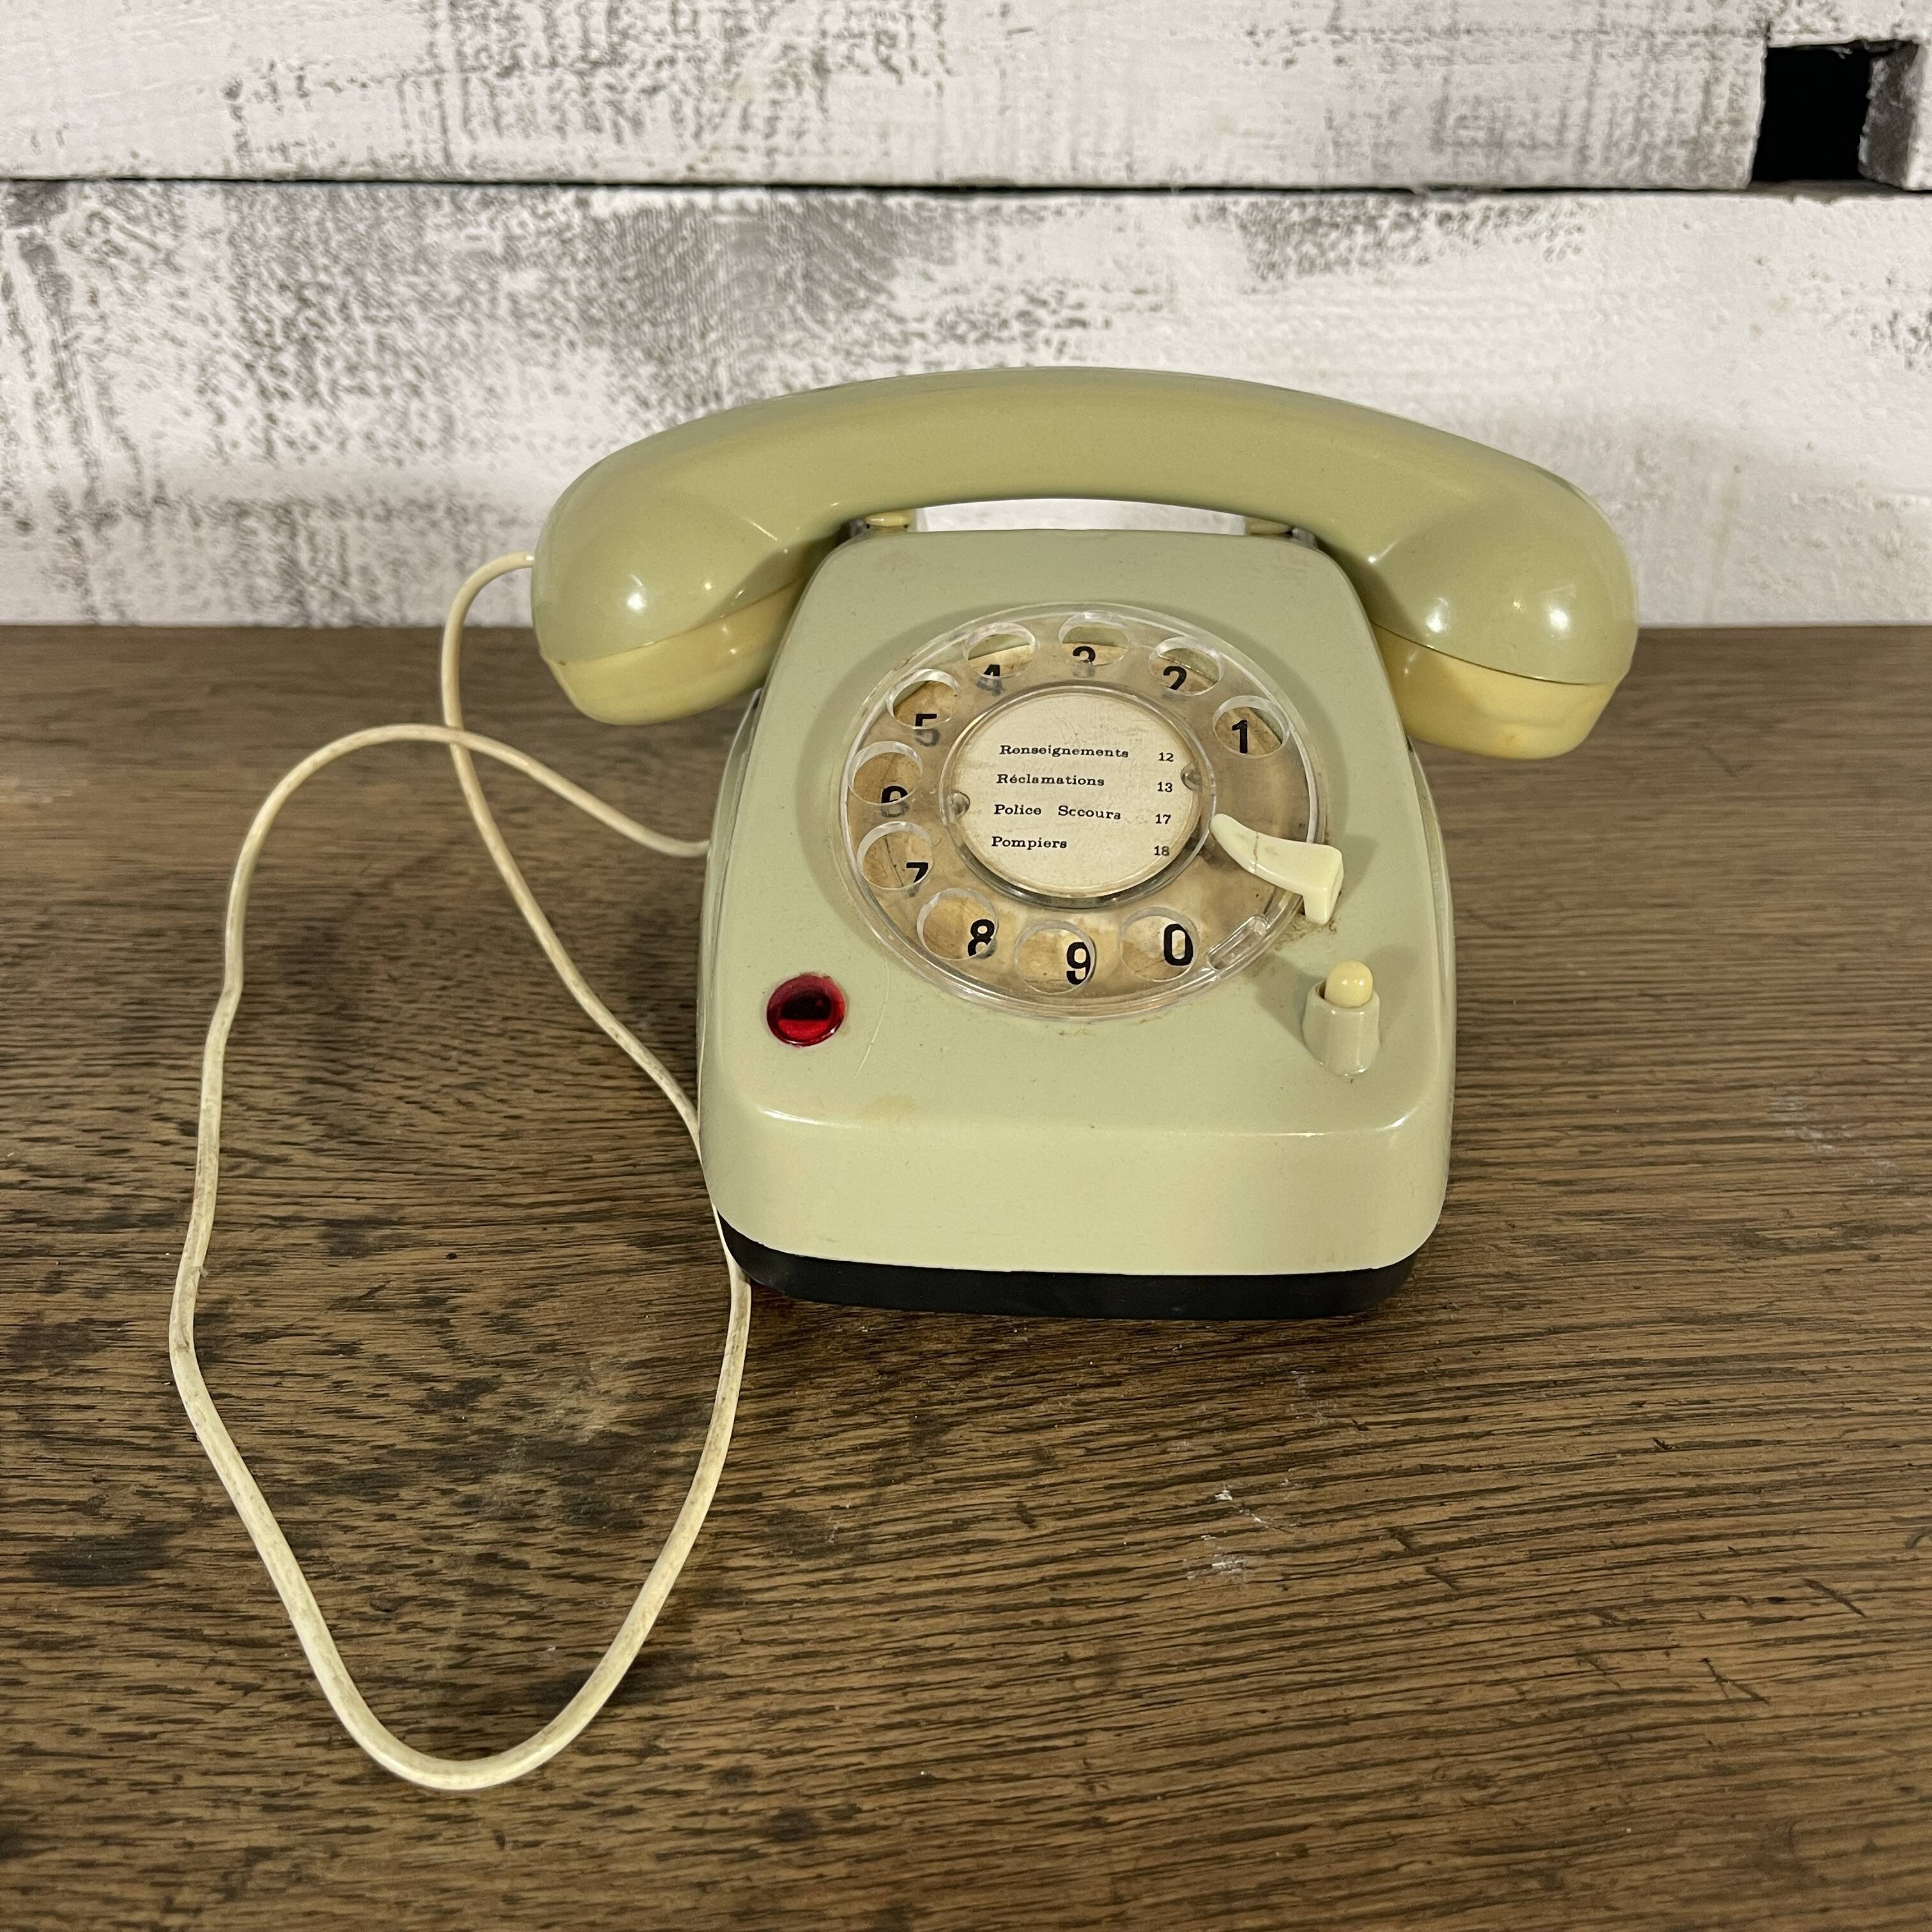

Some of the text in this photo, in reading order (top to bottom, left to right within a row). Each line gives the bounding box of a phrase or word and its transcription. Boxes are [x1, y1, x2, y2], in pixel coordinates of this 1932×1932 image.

[999, 745, 1174, 762] Renseignements 12
[1231, 719, 1248, 755] 1
[996, 774, 1173, 793] Réclamations 13
[993, 804, 1042, 816] Police
[1155, 813, 1172, 825] 17
[991, 836, 1170, 857] Pompiers 18
[906, 862, 929, 897] 7
[967, 919, 997, 960] 8
[1163, 923, 1193, 966] 0
[1066, 941, 1091, 985] 9
